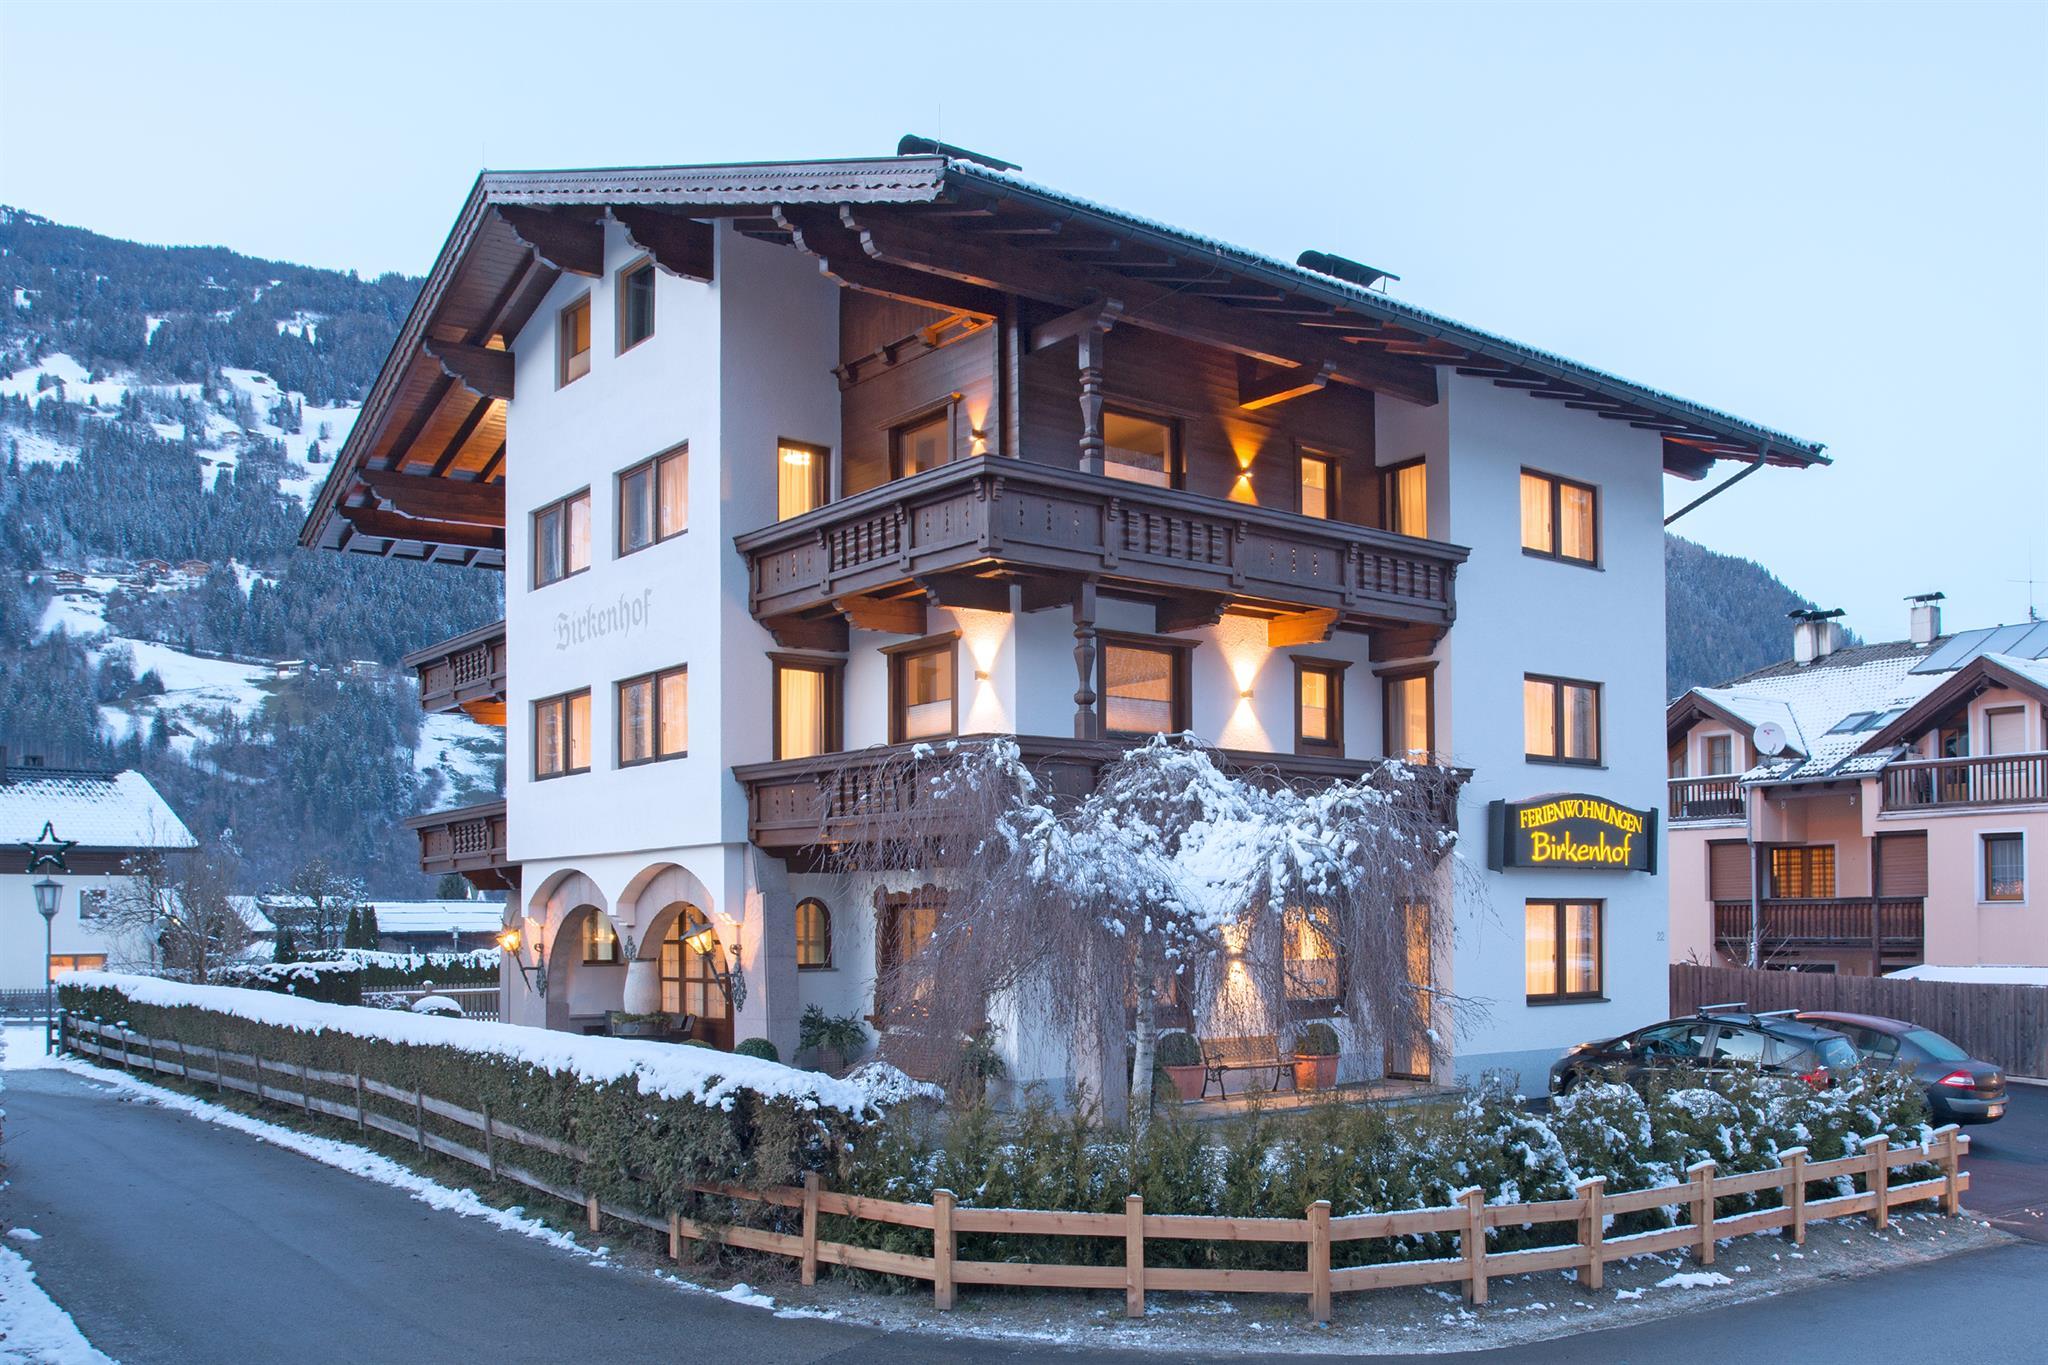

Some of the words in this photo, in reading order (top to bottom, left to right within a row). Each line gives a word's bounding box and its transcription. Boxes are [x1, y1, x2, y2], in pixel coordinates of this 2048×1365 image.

[554, 588, 652, 650] Birkenhof
[1520, 800, 1643, 833] FERIENWOHNUNGEN
[1531, 831, 1632, 866] Birkenhof
[1656, 931, 1665, 942] 22
